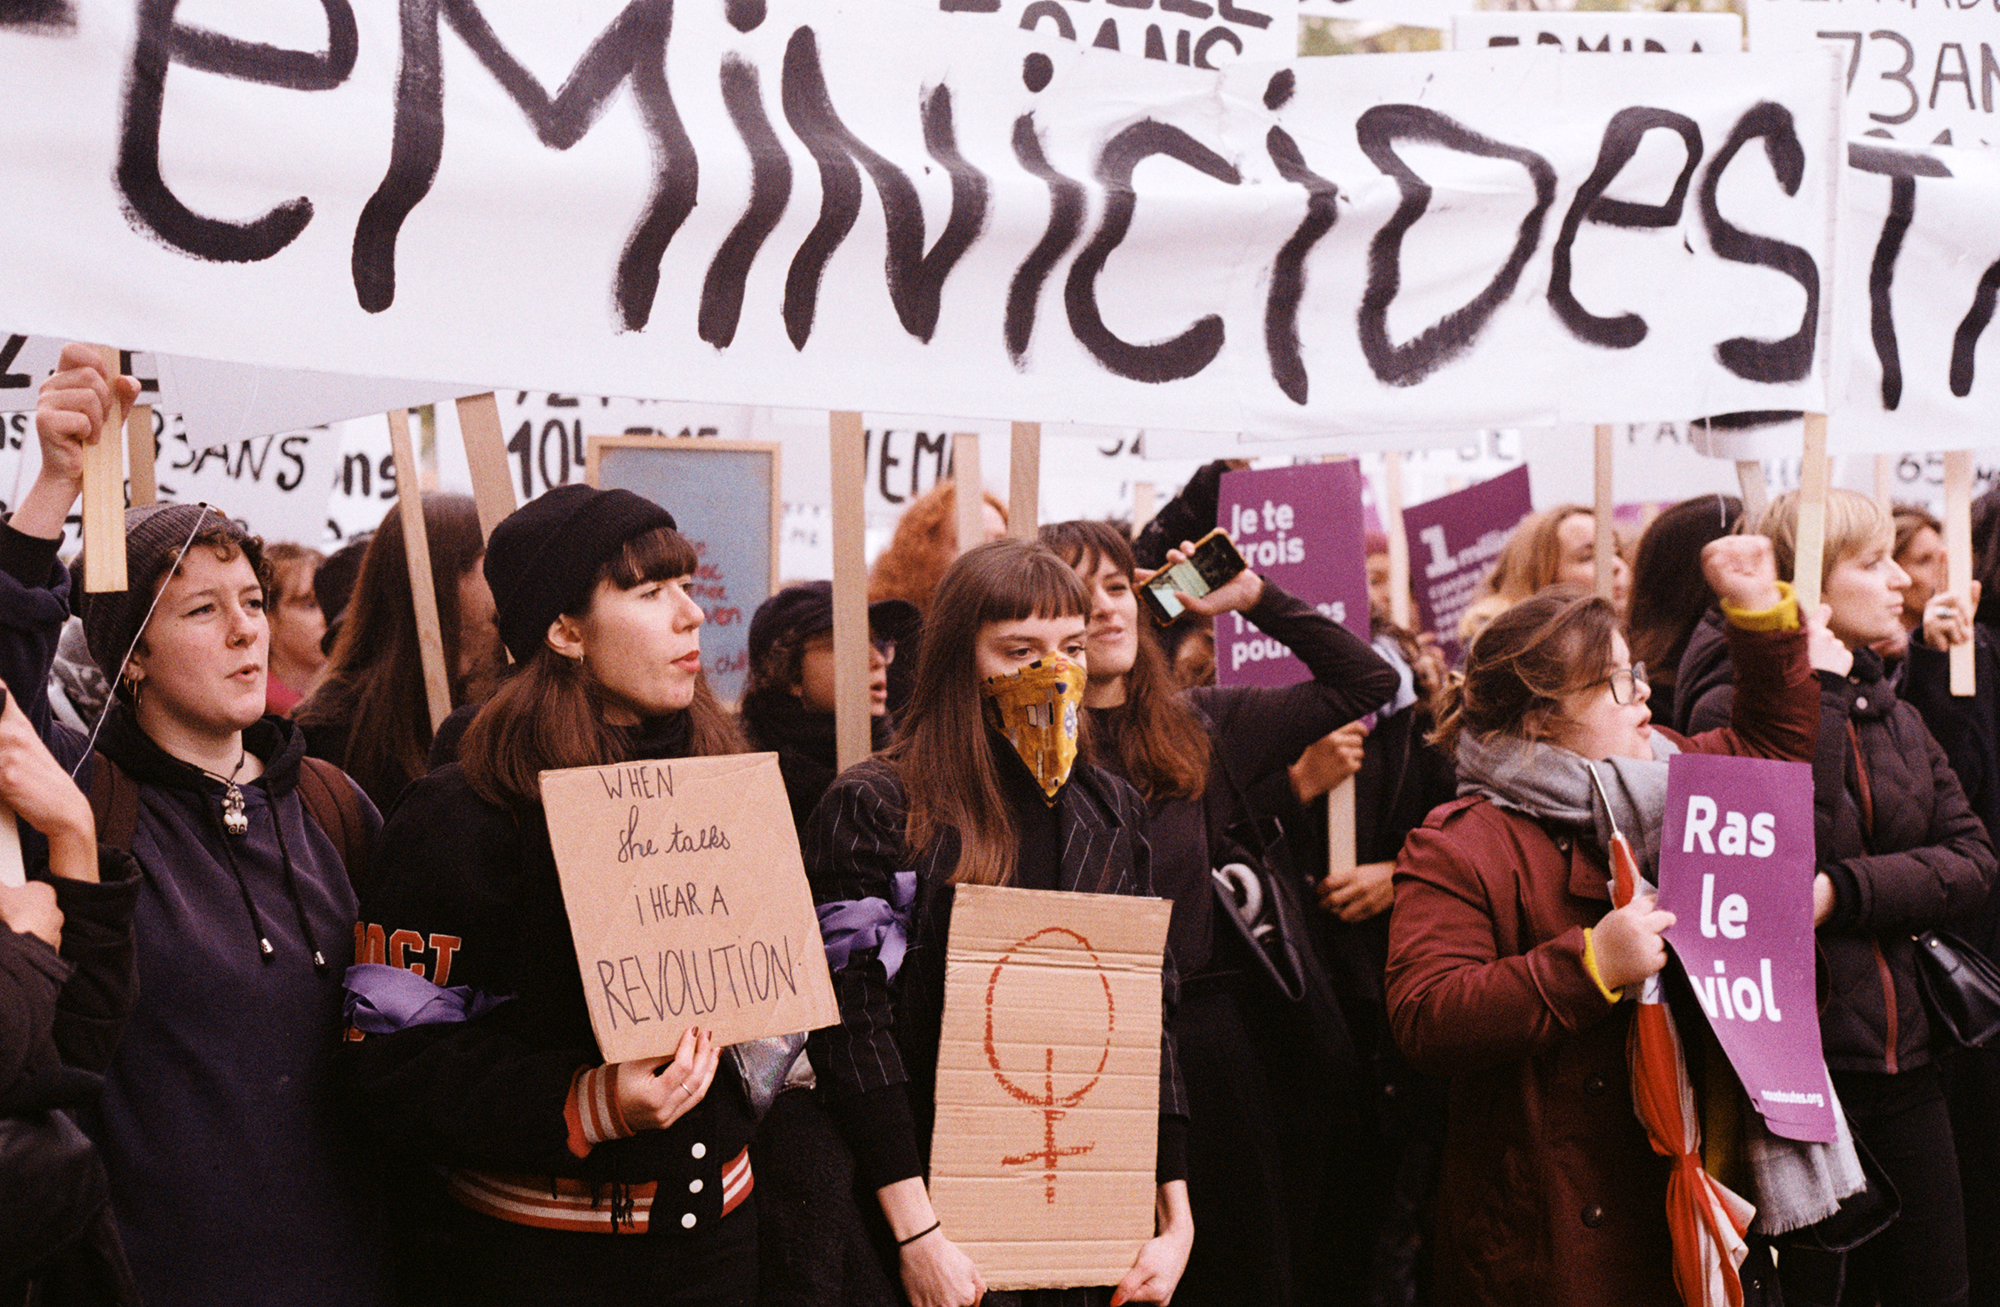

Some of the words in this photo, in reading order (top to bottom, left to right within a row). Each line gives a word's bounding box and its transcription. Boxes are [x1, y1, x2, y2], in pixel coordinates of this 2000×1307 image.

[1262, 499, 1295, 532] te
[1420, 524, 1458, 579] 1
[598, 764, 675, 799] WHEN
[664, 821, 732, 854] talks
[1682, 794, 1776, 858] Ras
[649, 881, 704, 923] HEAR
[710, 884, 730, 916] A
[1699, 873, 1749, 940] le
